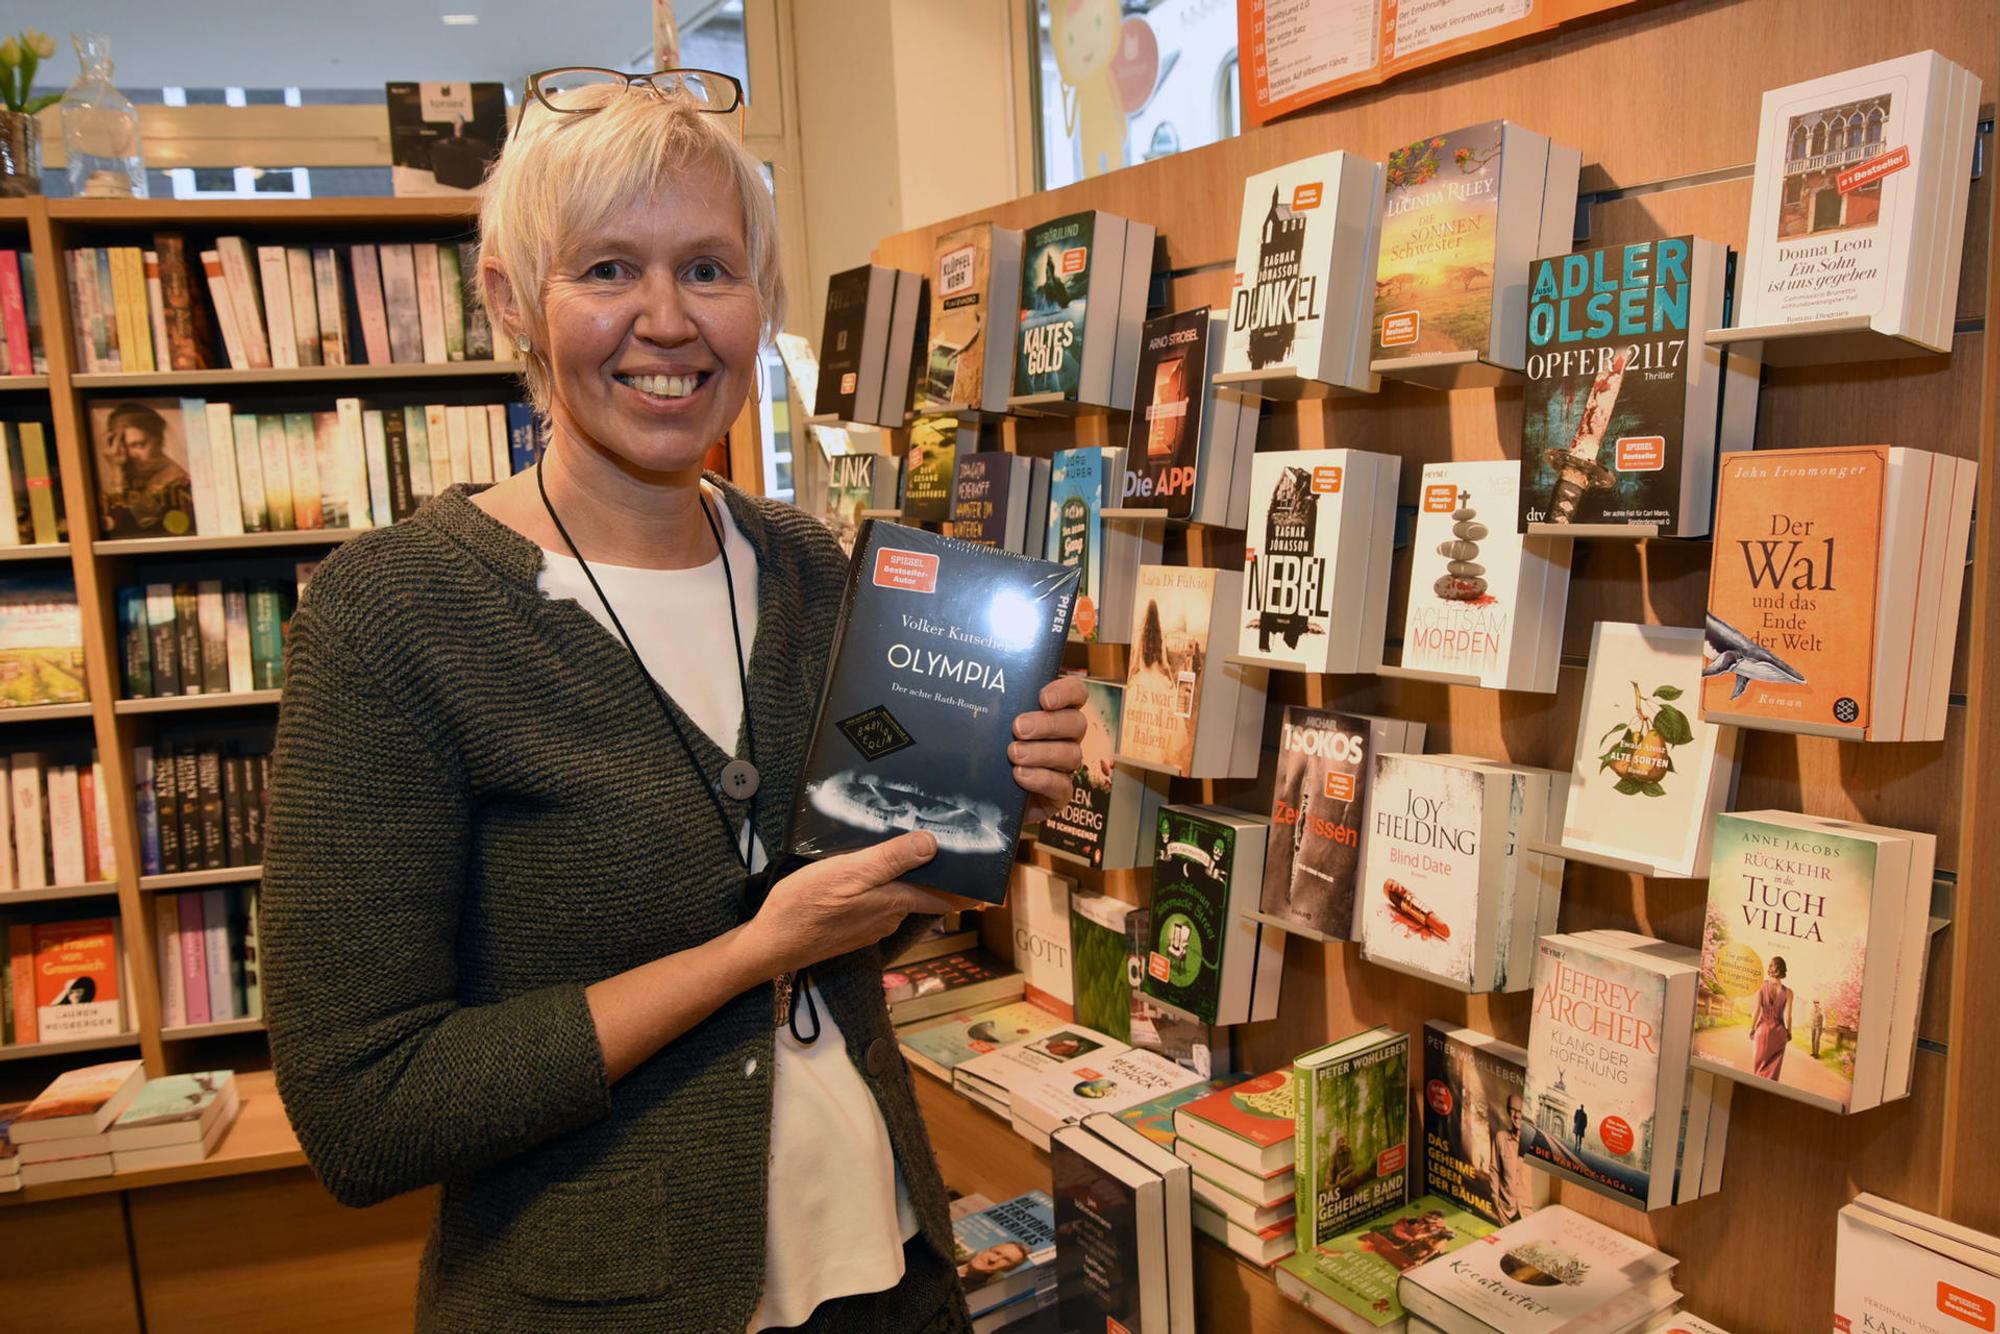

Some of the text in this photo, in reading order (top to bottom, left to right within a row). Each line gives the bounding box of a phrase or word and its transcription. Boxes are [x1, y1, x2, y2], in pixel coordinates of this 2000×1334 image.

[1854, 152, 1905, 182] Bestseller
[1388, 178, 1495, 217] LUCINDA RILEY
[1410, 215, 1483, 241] SONNEN
[1418, 214, 1434, 226] DIE
[1264, 250, 1296, 267] RAGNAR
[1391, 236, 1463, 261] Schwester
[1779, 238, 1872, 262] Donna Leon
[943, 253, 971, 276] KLÜPFEL
[1531, 239, 1689, 303] ADLER
[1790, 256, 1856, 276] Ein Sohn
[947, 272, 966, 290] KOBR
[1768, 268, 1877, 292] ist uns gegeben
[1233, 275, 1320, 333] DUNKEL
[1528, 284, 1690, 346] OLSEN
[1023, 320, 1075, 355] KALTES
[1149, 328, 1199, 351] ARNO STROBEL
[1028, 347, 1063, 375] GOLD
[1527, 340, 1684, 380] OPFER 2117
[1644, 371, 1675, 381] Thriller
[828, 456, 872, 488] LINK
[1124, 467, 1194, 497] Die APP
[1734, 464, 1866, 480] John Ironmonger
[1526, 507, 1546, 523] dtv
[1770, 514, 1814, 536] Der
[1275, 525, 1306, 538] RAGNAR
[1269, 538, 1308, 552] JÓNASSON
[890, 555, 925, 567] SPIEGEL
[1736, 537, 1837, 591] Wal
[893, 576, 917, 585] Autor
[1142, 573, 1208, 588] Luca Di Fulvio
[1246, 554, 1329, 617] NEBEL
[1052, 593, 1070, 633] PIPER
[1752, 593, 1817, 610] und das
[902, 614, 946, 636] Volker
[1411, 607, 1508, 633] ACHTSAM
[1762, 613, 1807, 631] Ende
[1412, 627, 1500, 654] MORDEN
[1750, 631, 1822, 652] der Welt
[887, 644, 1006, 693] OLYMPIA
[892, 682, 989, 714] Der achte Rath-Roman
[1151, 690, 1174, 706] war
[1759, 693, 1803, 708] Roman
[1166, 714, 1178, 731] in
[1305, 716, 1338, 730] MICHAEL
[1284, 724, 1364, 765] TSOKOS
[1620, 738, 1642, 750] Ewald
[1610, 751, 1669, 769] ALTE SORTEN
[1405, 788, 1444, 823] JOY
[1046, 819, 1099, 843] DIE SCHWEIGENDE
[1376, 812, 1476, 856] FIELDING
[1742, 833, 1841, 858] ANNE JACOBS
[1389, 847, 1452, 876] Blind Date
[1744, 852, 1833, 881] RÜCKKEHR
[1773, 875, 1795, 887] in die
[1742, 874, 1826, 918] TUCH
[1742, 905, 1825, 943] VILLA
[1015, 928, 1067, 969] GOTT
[1549, 960, 1640, 1013] JEFFREY
[1535, 981, 1655, 1054] ARCHER
[1319, 1040, 1408, 1080] PETER WOHLLEBEN
[1427, 1036, 1525, 1086] PETER WOHLLEBEN
[1551, 1029, 1629, 1068] KLANG DER
[1550, 1047, 1628, 1084] HOFFNUNG
[1428, 1132, 1449, 1152] DAS
[1535, 1146, 1554, 1161] DIE
[1428, 1146, 1476, 1179] GEHEIME
[1428, 1161, 1462, 1186] LEBEN
[1015, 1197, 1039, 1211] DIE
[1318, 1175, 1404, 1221] GEHEIME BAND
[1319, 1187, 1341, 1207] DAS
[1427, 1173, 1493, 1214] DER BÄUME
[984, 1210, 1044, 1247] AMERIKAS
[1864, 1296, 1916, 1326] FERDINAND
